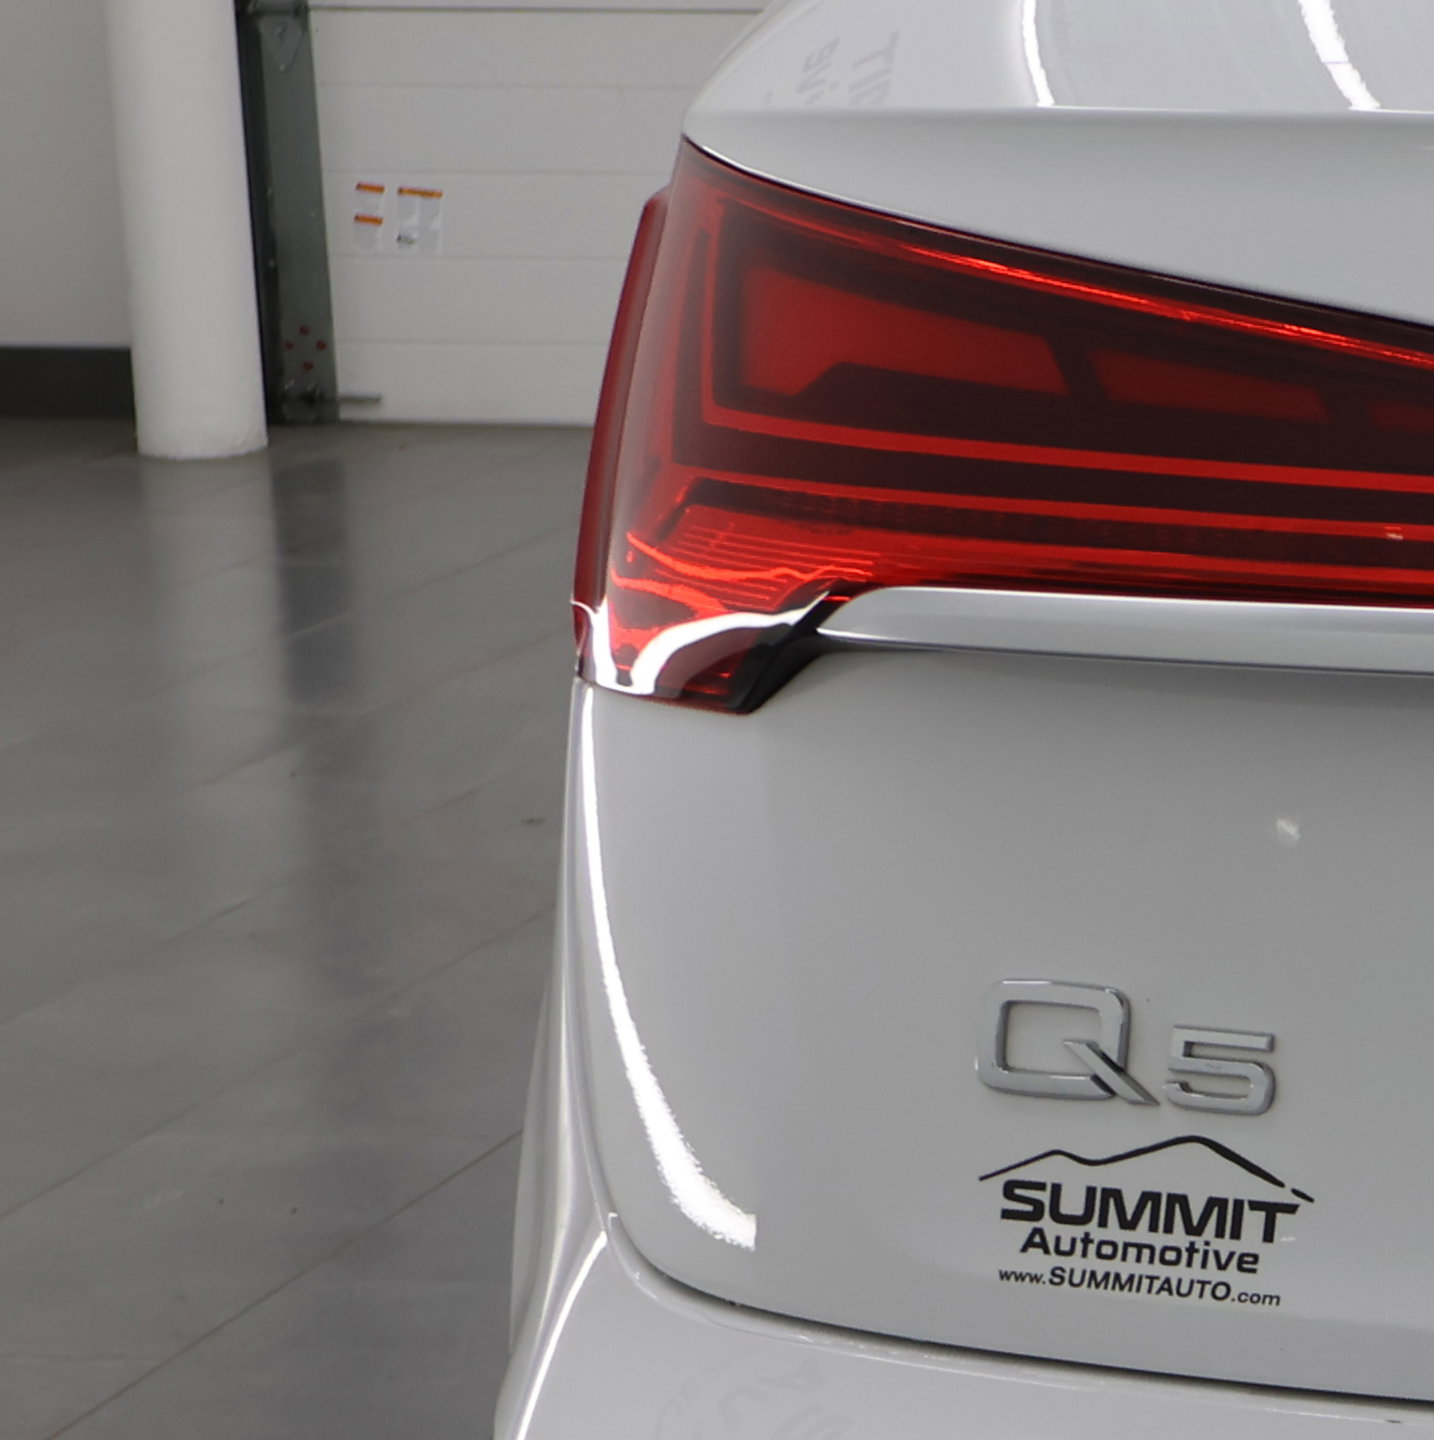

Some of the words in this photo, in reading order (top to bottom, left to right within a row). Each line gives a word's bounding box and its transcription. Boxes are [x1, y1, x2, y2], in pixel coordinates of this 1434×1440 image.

[974, 977, 1276, 1117] Q5
[999, 1178, 1301, 1245] SUMMIT
[1018, 1225, 1261, 1275] Automotive
[997, 1265, 1282, 1307] www.SUMMITAUTO.com
